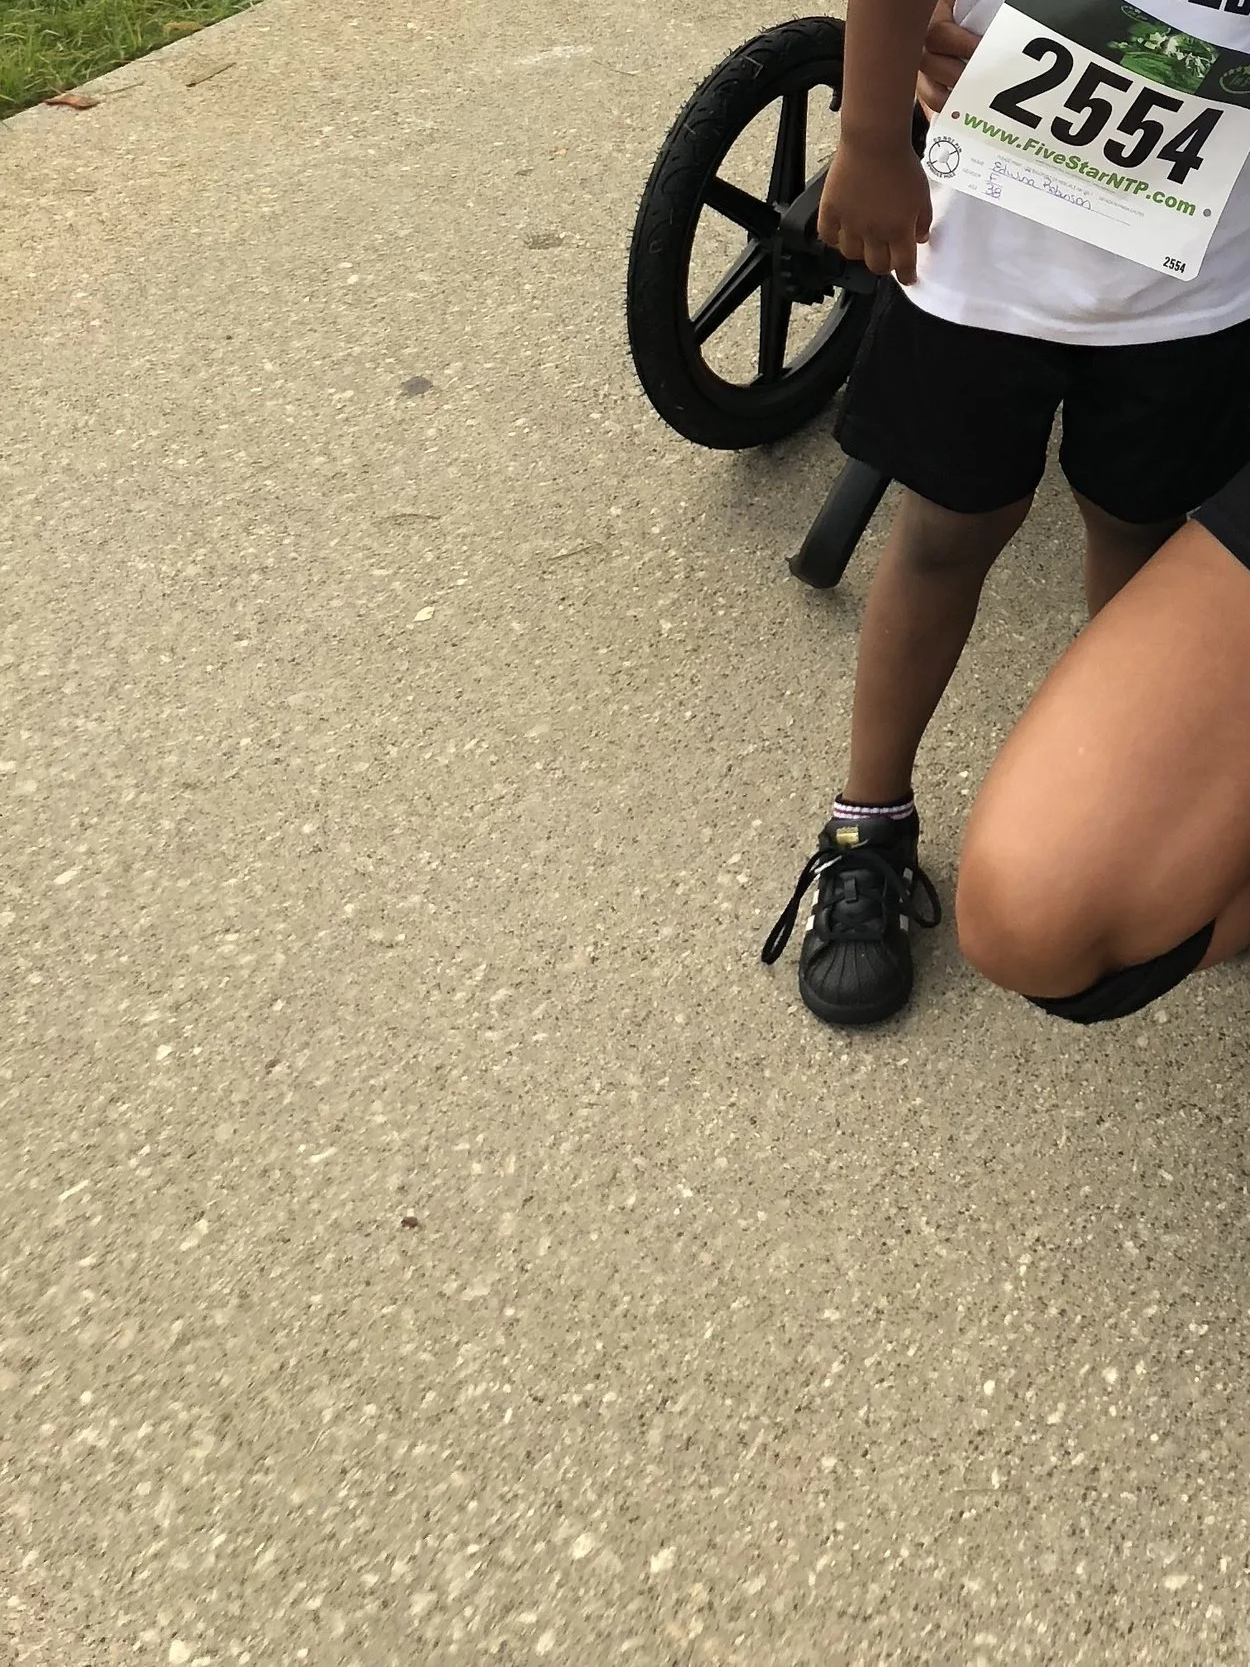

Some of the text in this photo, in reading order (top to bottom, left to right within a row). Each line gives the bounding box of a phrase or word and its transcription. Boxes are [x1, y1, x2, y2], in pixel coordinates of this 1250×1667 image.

[962, 110, 1197, 217] www.FiveStarNTP.com
[989, 36, 1224, 185] 2554
[1163, 256, 1187, 274] 2554
